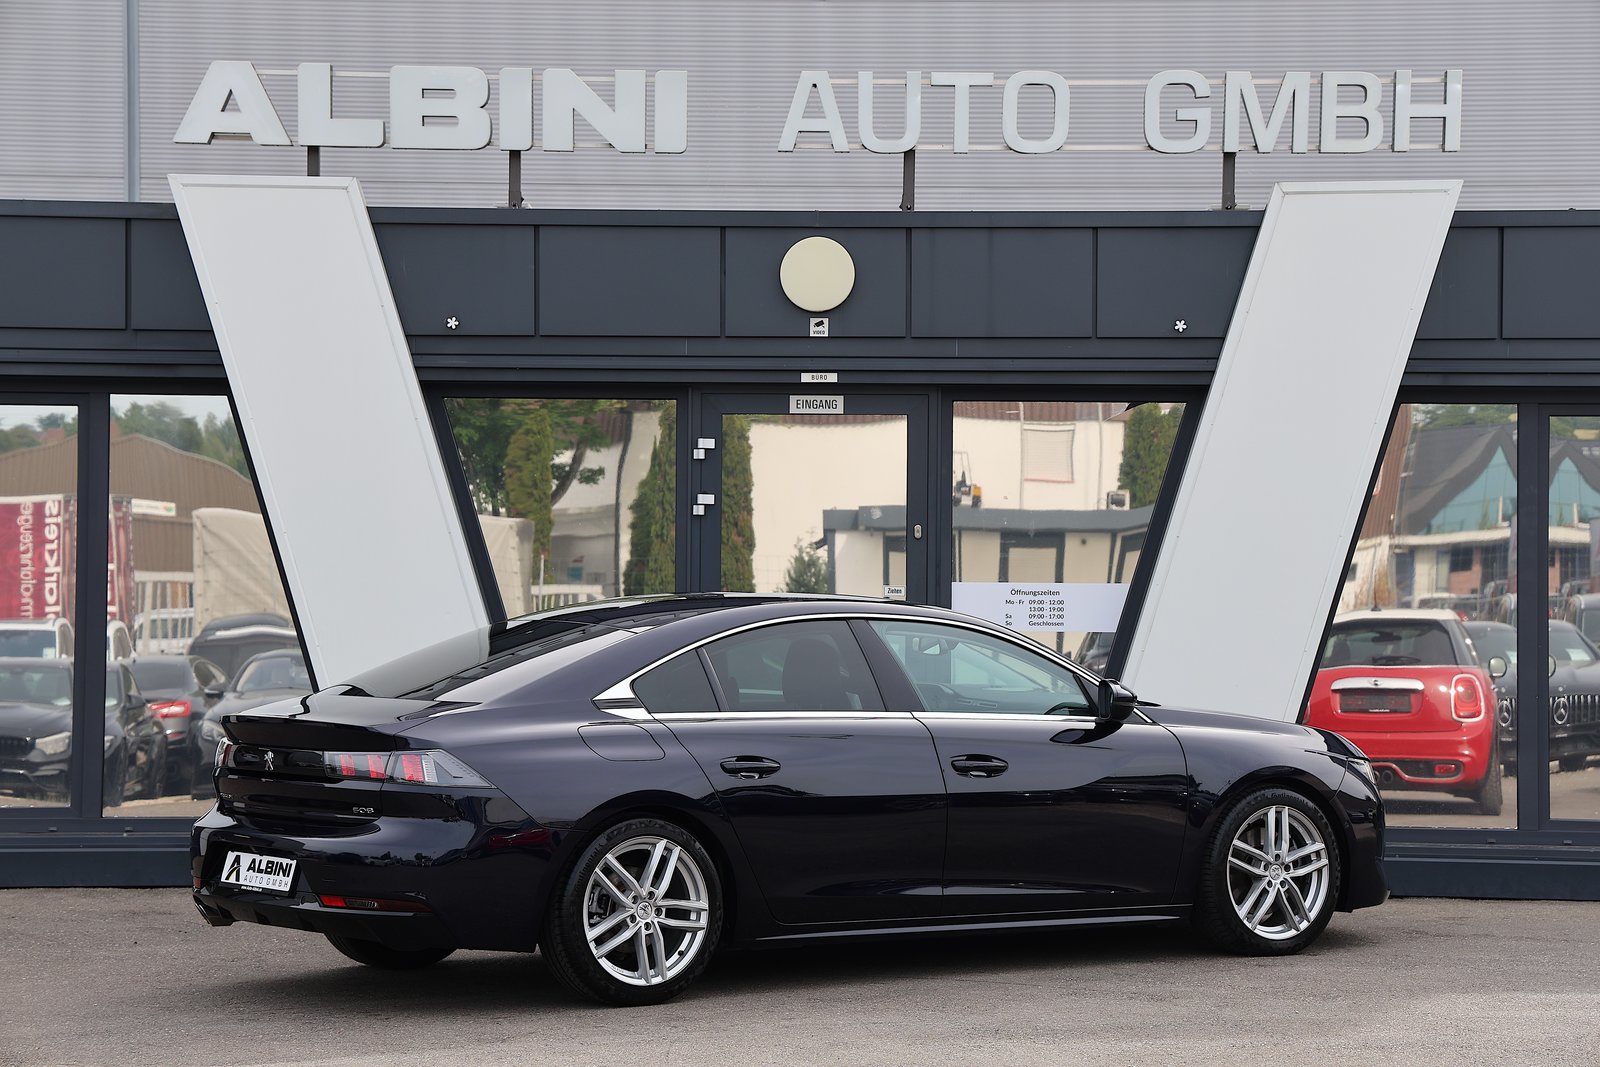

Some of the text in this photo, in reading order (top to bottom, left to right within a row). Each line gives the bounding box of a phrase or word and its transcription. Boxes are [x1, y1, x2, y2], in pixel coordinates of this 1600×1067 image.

[173, 60, 1464, 155] ALBINI AUTO GMBH
[796, 399, 838, 410] EINGANG
[1010, 588, 1060, 596] Öffnungszeiten
[246, 858, 293, 878] ALBINI
[243, 874, 289, 888] AUTO GMBH
